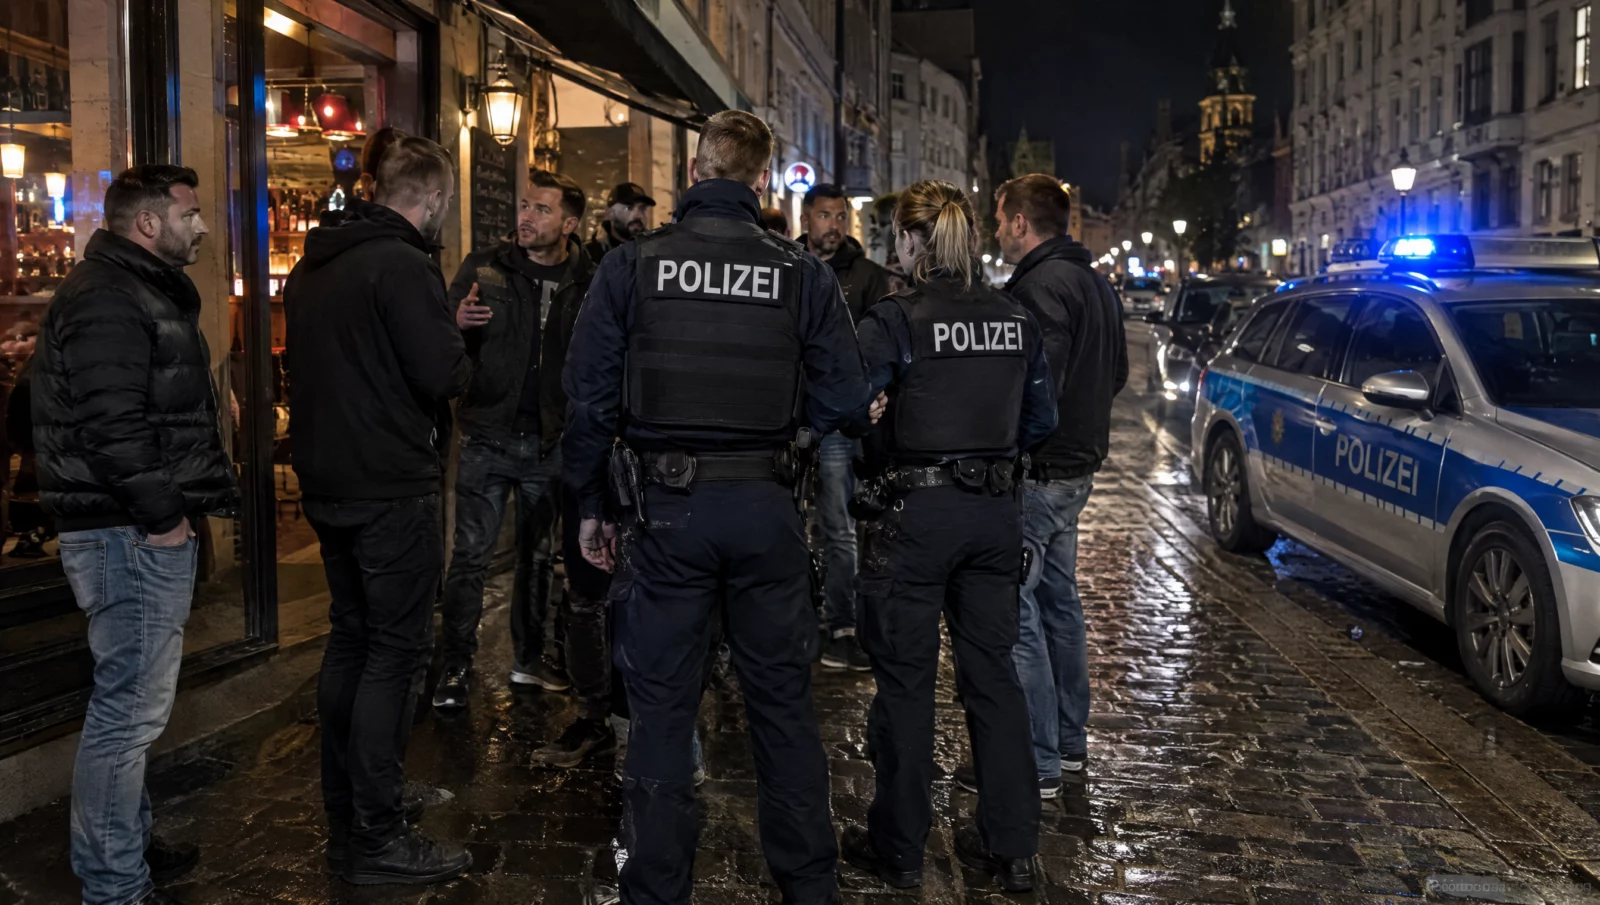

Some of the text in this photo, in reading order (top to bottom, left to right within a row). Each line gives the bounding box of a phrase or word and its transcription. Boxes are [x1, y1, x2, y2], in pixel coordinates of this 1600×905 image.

[657, 260, 780, 299] POLIZEI
[933, 321, 1023, 352] POLIZEI
[1335, 433, 1420, 497] POLIZEI
